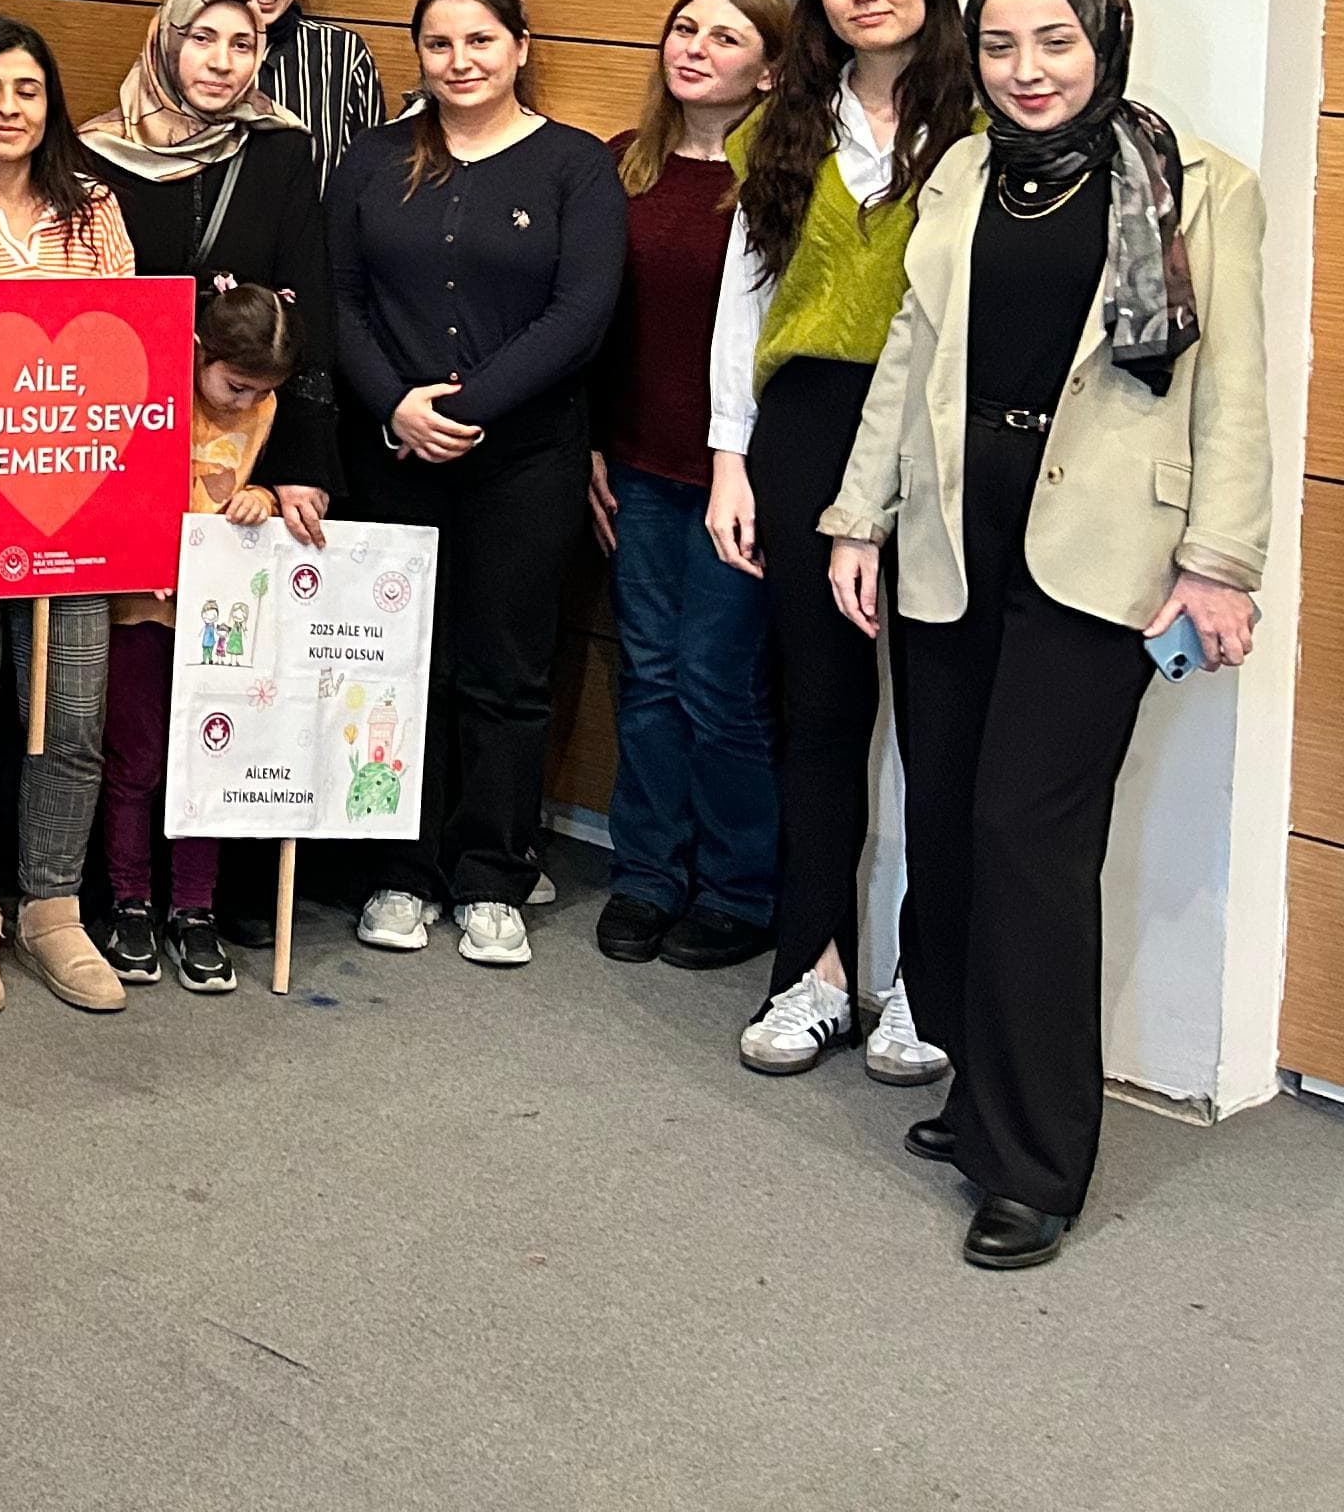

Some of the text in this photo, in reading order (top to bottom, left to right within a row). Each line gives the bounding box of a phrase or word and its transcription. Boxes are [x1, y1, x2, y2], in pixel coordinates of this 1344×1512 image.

[13, 357, 86, 396] AİLE,
[87, 396, 175, 432] SEVGİ
[310, 622, 383, 638] 2025 AİLE YILI
[309, 647, 384, 662] KUTLU OLSUN
[245, 765, 292, 780] AİLEMİZ
[222, 789, 314, 804] İSTİKBALİMİZDİR
